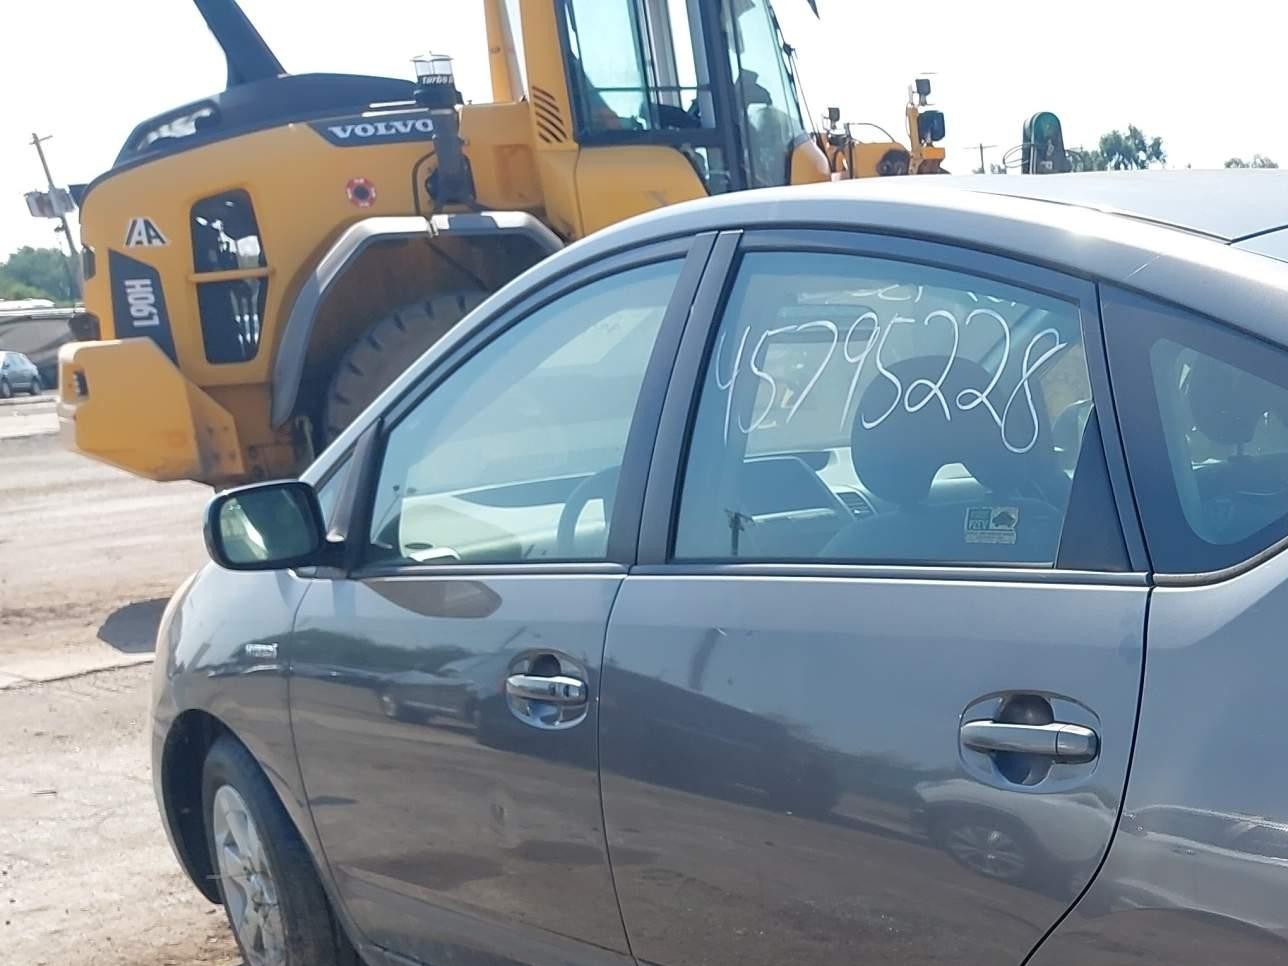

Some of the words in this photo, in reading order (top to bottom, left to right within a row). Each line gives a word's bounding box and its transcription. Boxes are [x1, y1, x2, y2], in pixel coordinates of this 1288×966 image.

[327, 118, 434, 139] VOLVO
[124, 278, 160, 327] L90H
[714, 307, 1058, 453] 45795228
